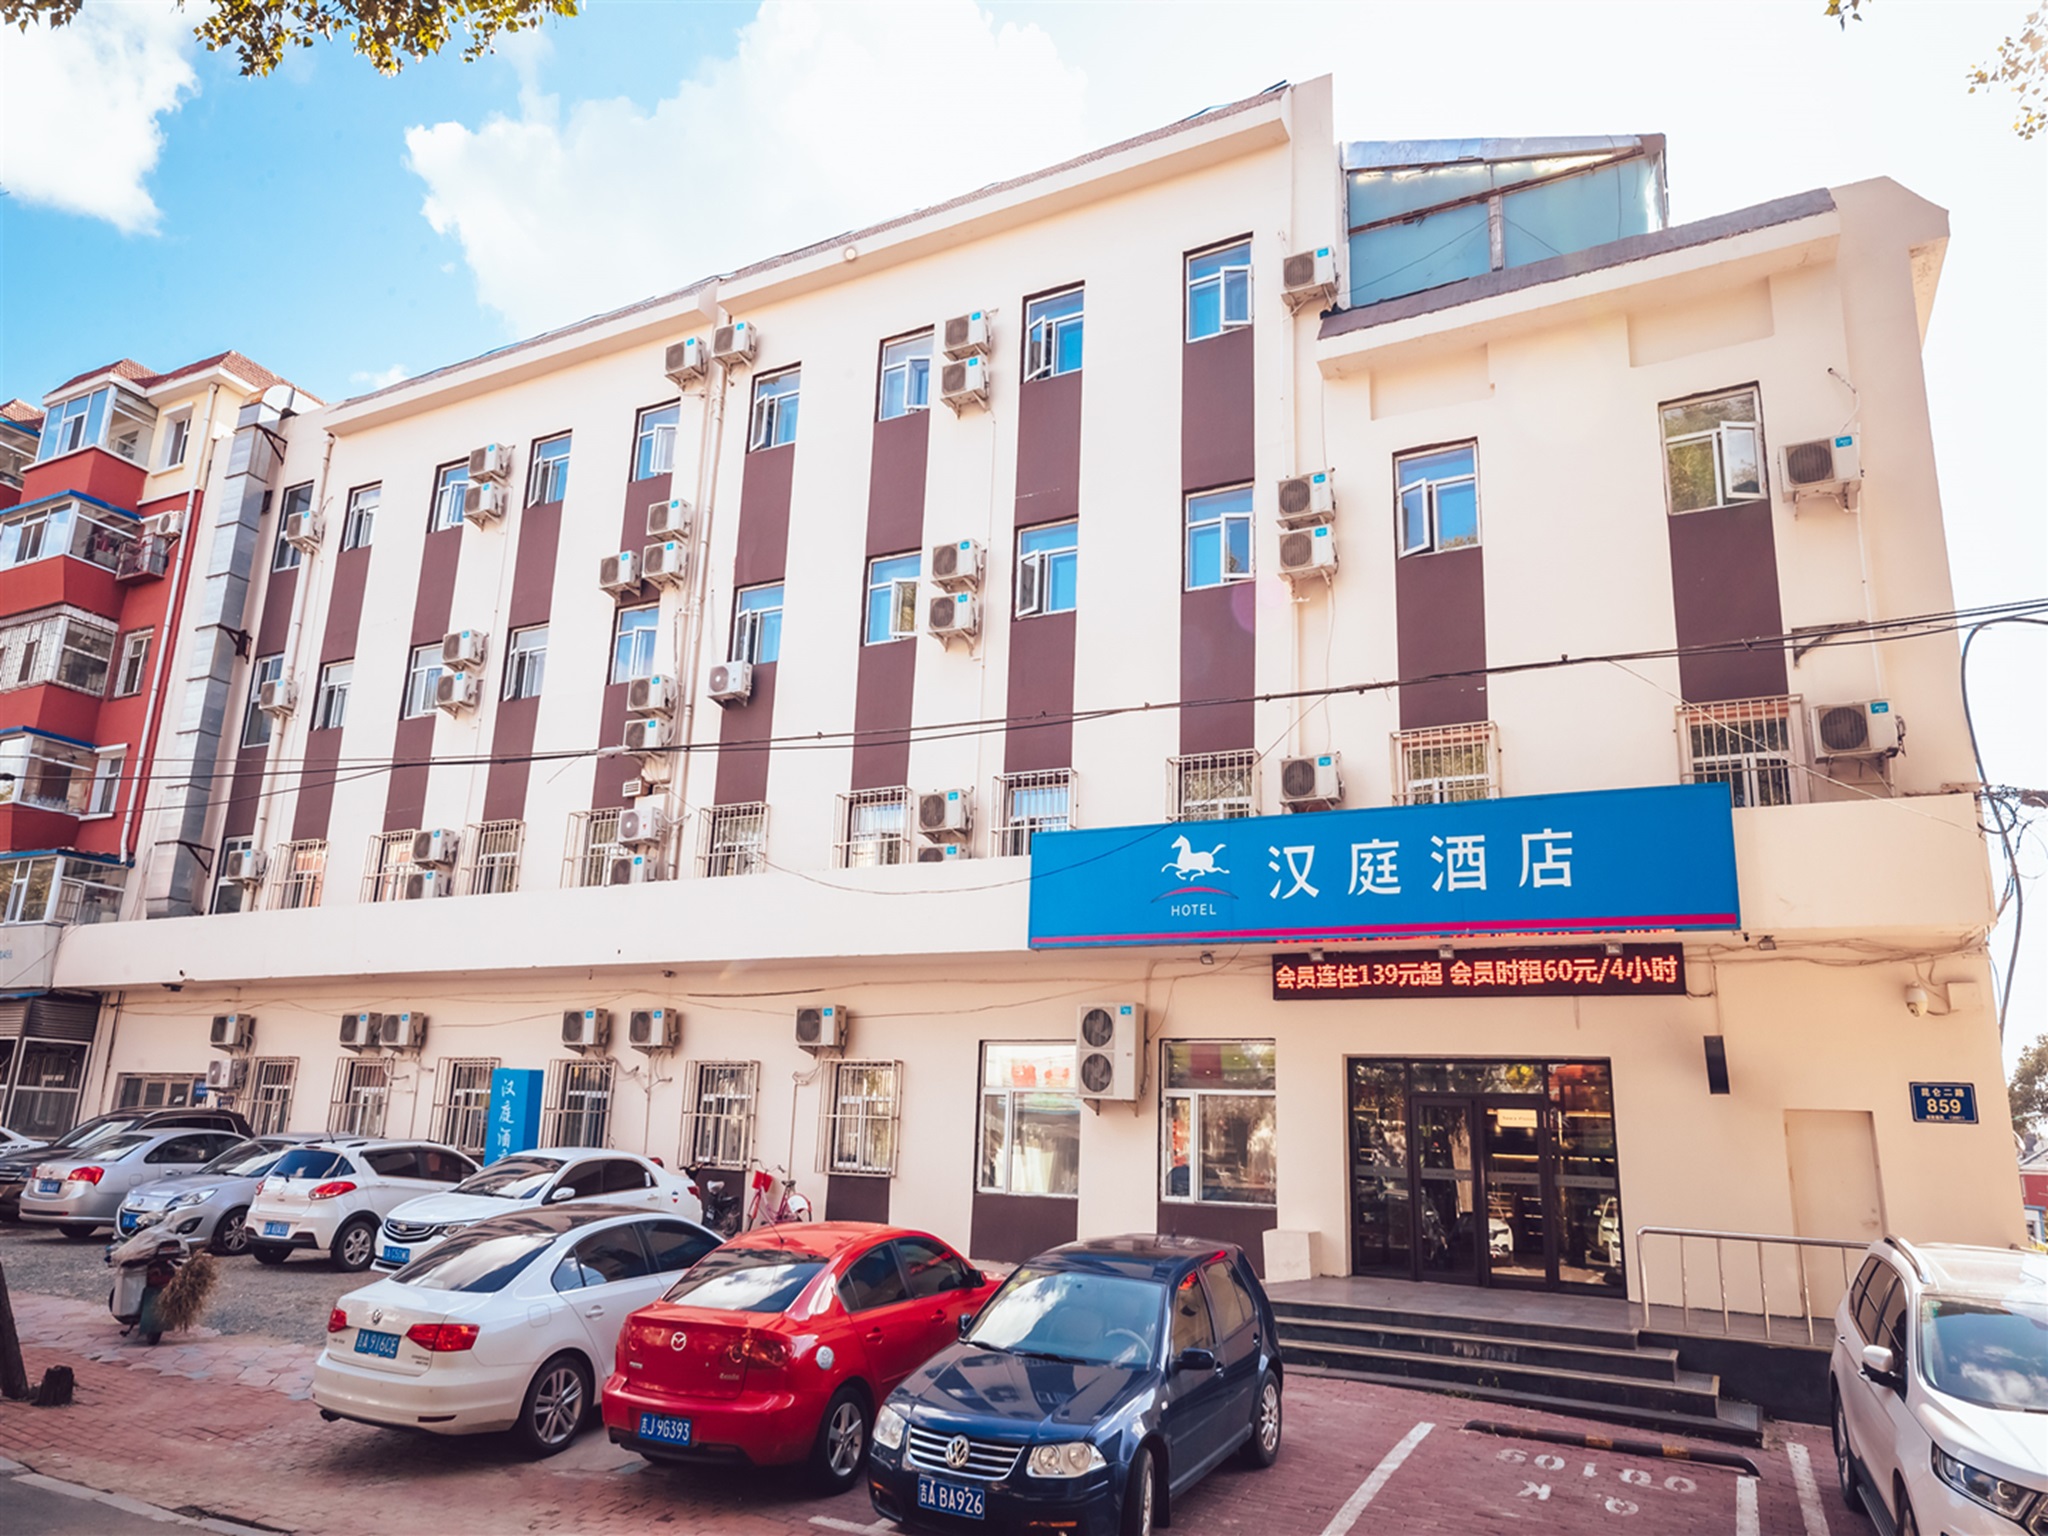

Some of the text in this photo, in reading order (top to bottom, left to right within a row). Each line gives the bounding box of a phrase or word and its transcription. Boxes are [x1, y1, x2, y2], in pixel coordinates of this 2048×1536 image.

[1268, 828, 1573, 899] 汉庭酒店
[1171, 903, 1217, 917] HOTEL
[1276, 955, 1677, 990] 会员连住139元起 会员时租60元/4小时
[1926, 1098, 1961, 1114] 859
